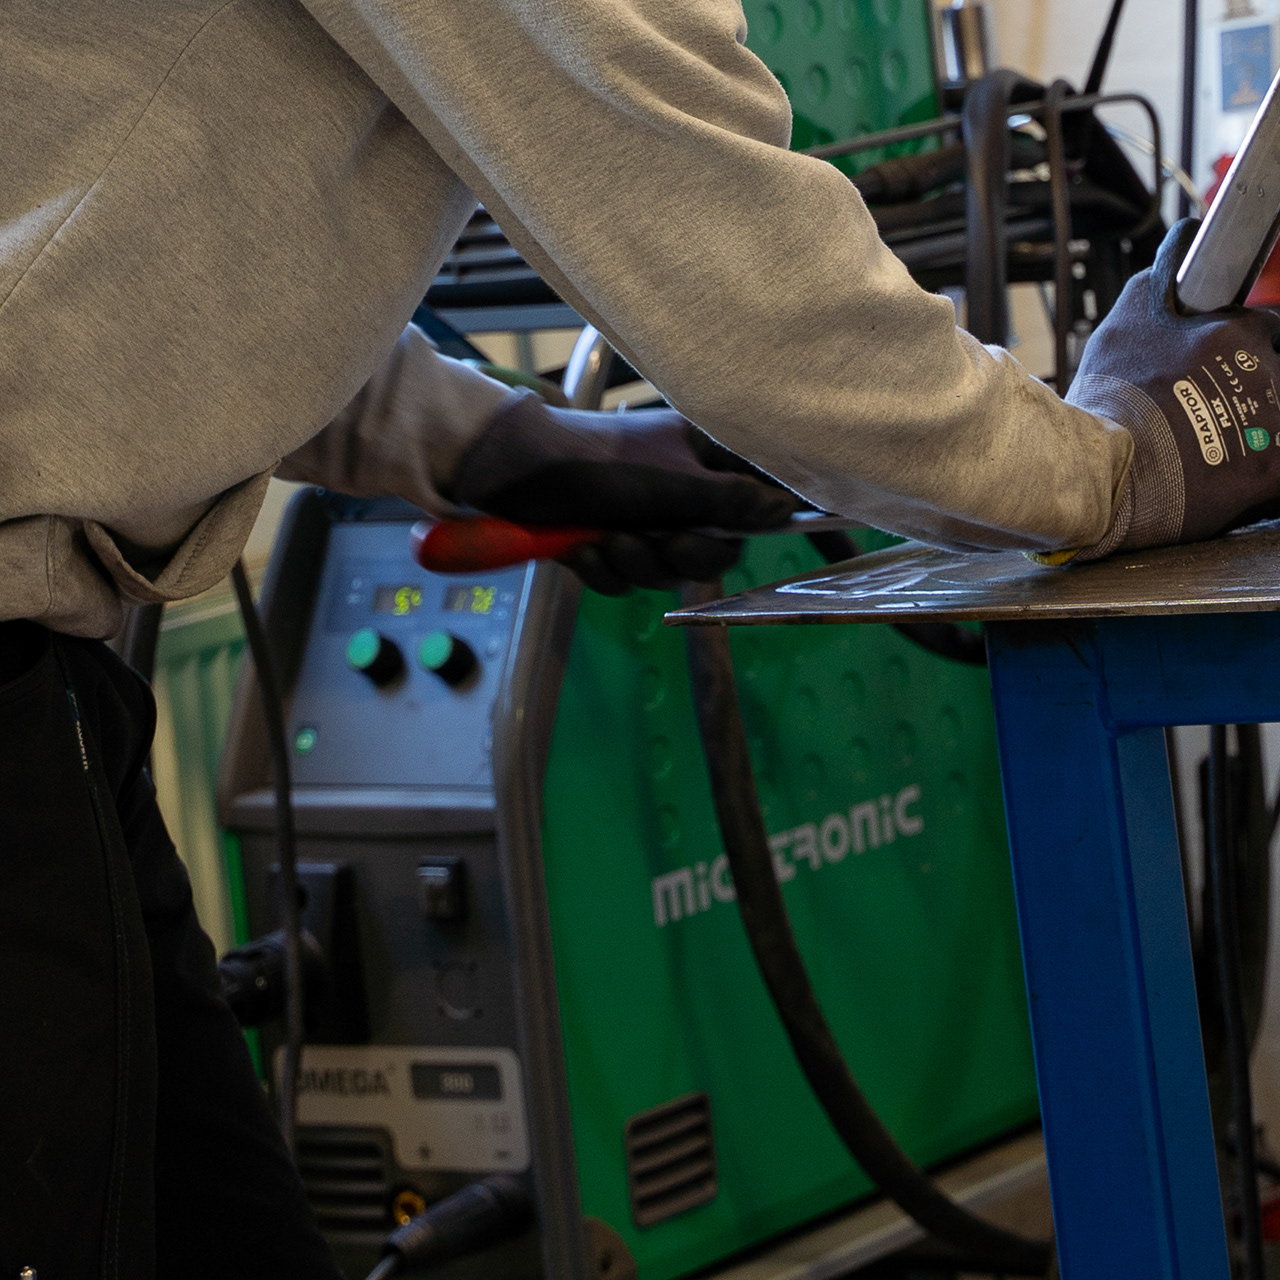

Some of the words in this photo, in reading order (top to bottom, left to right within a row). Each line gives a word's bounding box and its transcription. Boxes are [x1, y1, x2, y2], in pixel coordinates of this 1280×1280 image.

[1180, 387, 1214, 445] RAPTOR
[1210, 397, 1231, 429] FLEX
[651, 783, 924, 928] MIGTRONIC
